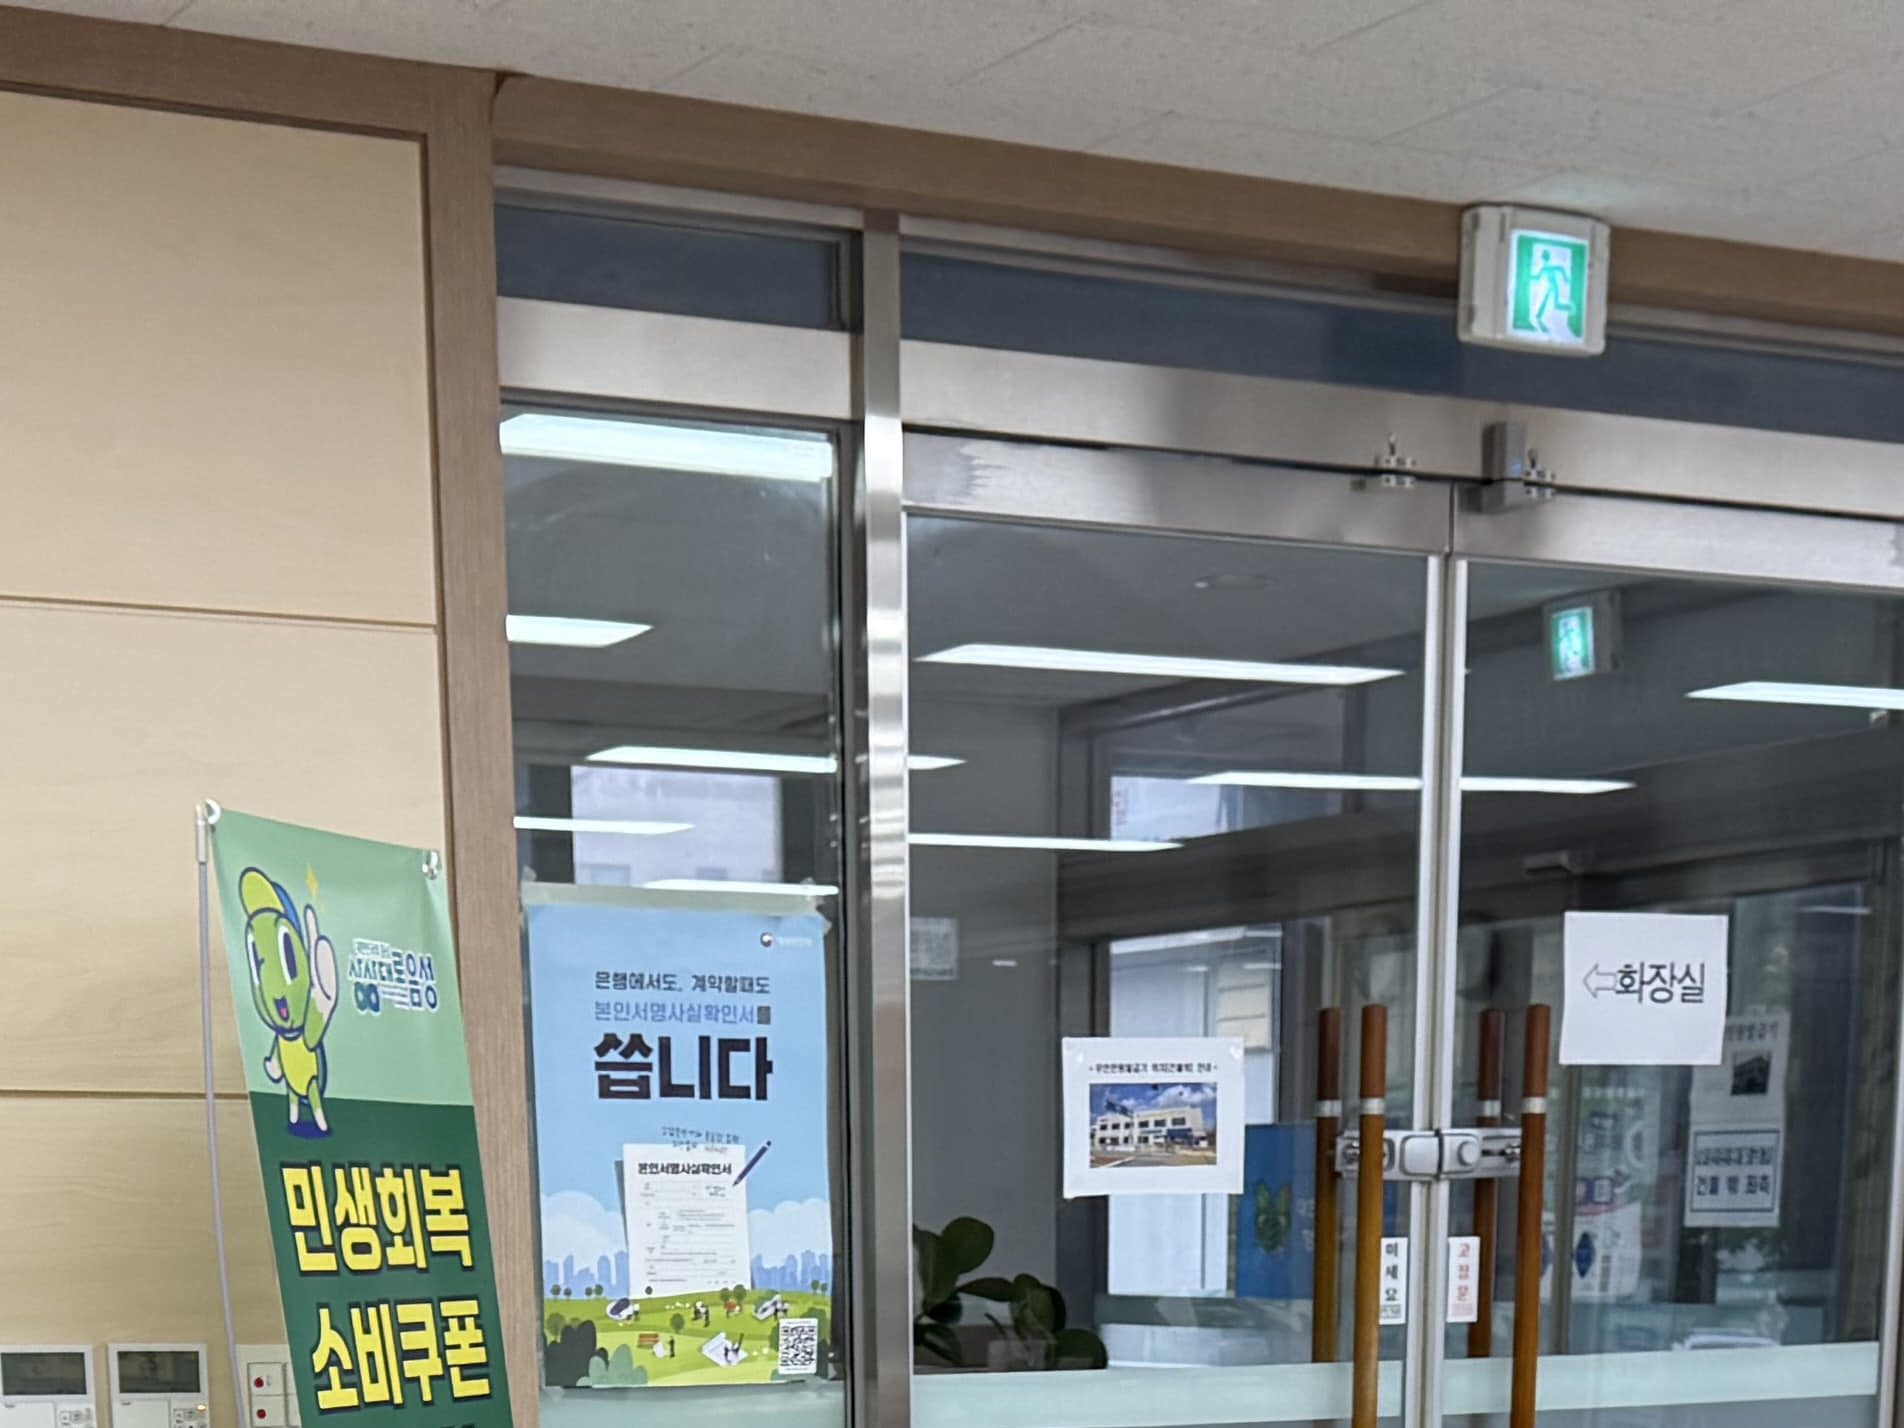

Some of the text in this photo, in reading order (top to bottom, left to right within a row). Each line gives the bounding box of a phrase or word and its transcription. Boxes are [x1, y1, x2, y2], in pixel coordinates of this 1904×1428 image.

[594, 1000, 772, 1025] 본인서명사실확인서를
[1614, 960, 1706, 1004] 화장실
[593, 1032, 774, 1101] 씁니다
[281, 1164, 475, 1272] 민생회복
[1384, 1241, 1399, 1302] 미세요
[1457, 1242, 1471, 1302] 고정문
[311, 1298, 493, 1411] 소비쿠폰
